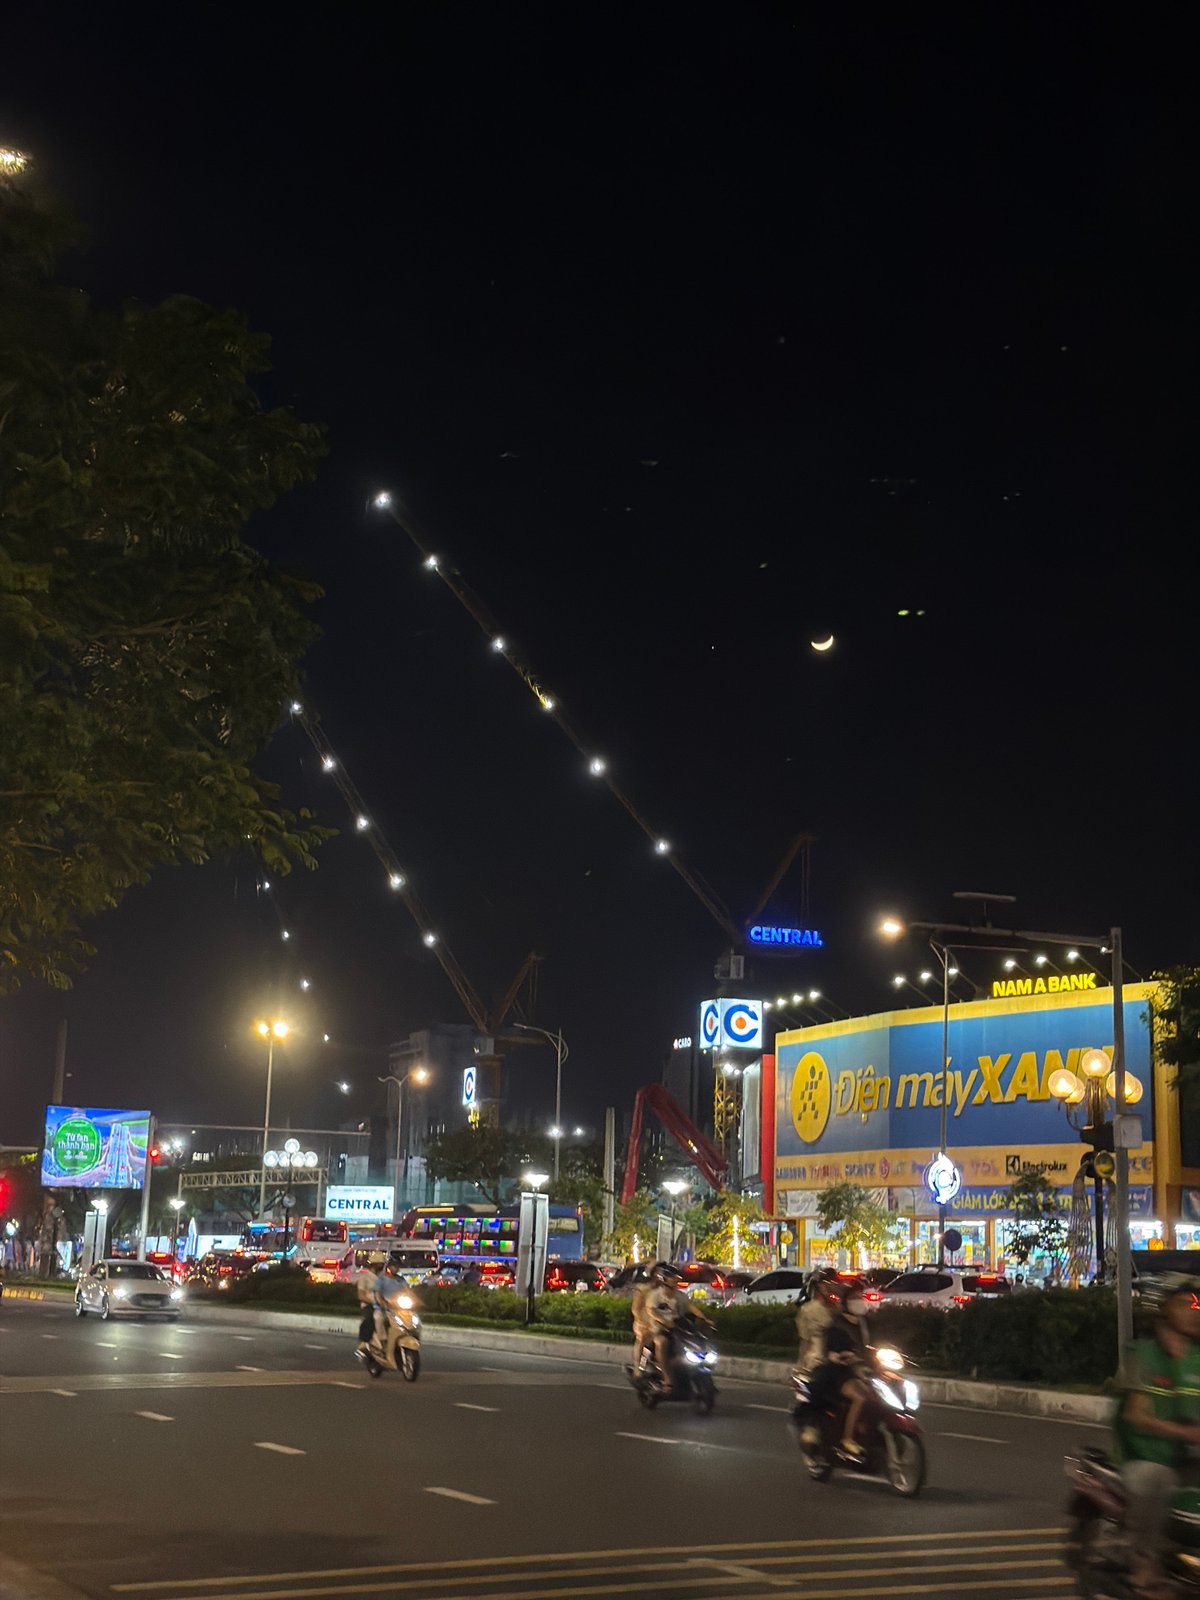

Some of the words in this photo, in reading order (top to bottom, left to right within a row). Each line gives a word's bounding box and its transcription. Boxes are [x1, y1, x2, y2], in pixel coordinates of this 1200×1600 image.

[750, 925, 823, 947] CENTRAL
[993, 978, 1031, 997] NAM
[1034, 977, 1047, 994] A
[1048, 973, 1096, 993] BANK
[834, 1064, 891, 1121] Điện
[896, 1056, 979, 1117] máy
[328, 1198, 390, 1210] CENTRAL
